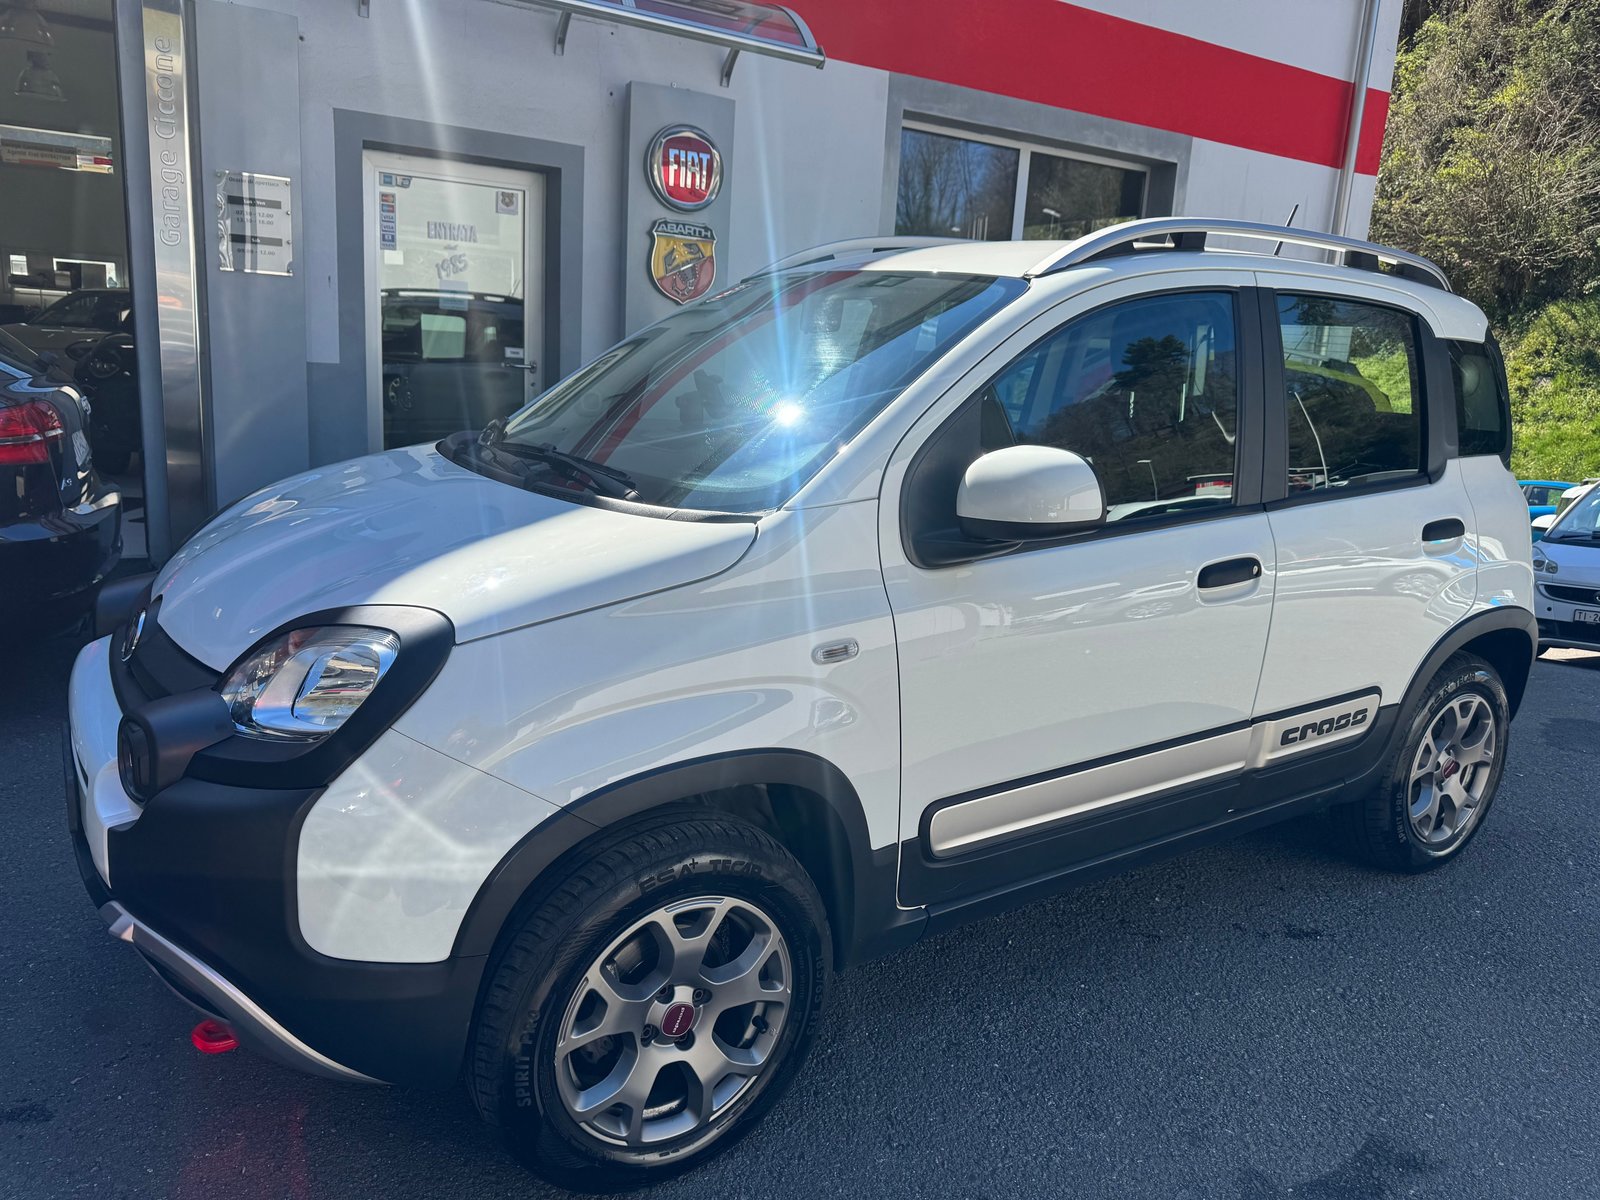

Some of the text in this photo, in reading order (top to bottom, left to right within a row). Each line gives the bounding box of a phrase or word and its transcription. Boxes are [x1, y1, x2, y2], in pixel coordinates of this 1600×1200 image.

[154, 36, 184, 247] Garage Ciccone
[668, 148, 711, 191] FIAT
[427, 221, 477, 243] ENTRATA
[658, 223, 711, 238] ABARTH
[435, 253, 468, 280] 1985
[515, 1056, 531, 1107] SPIRIT
